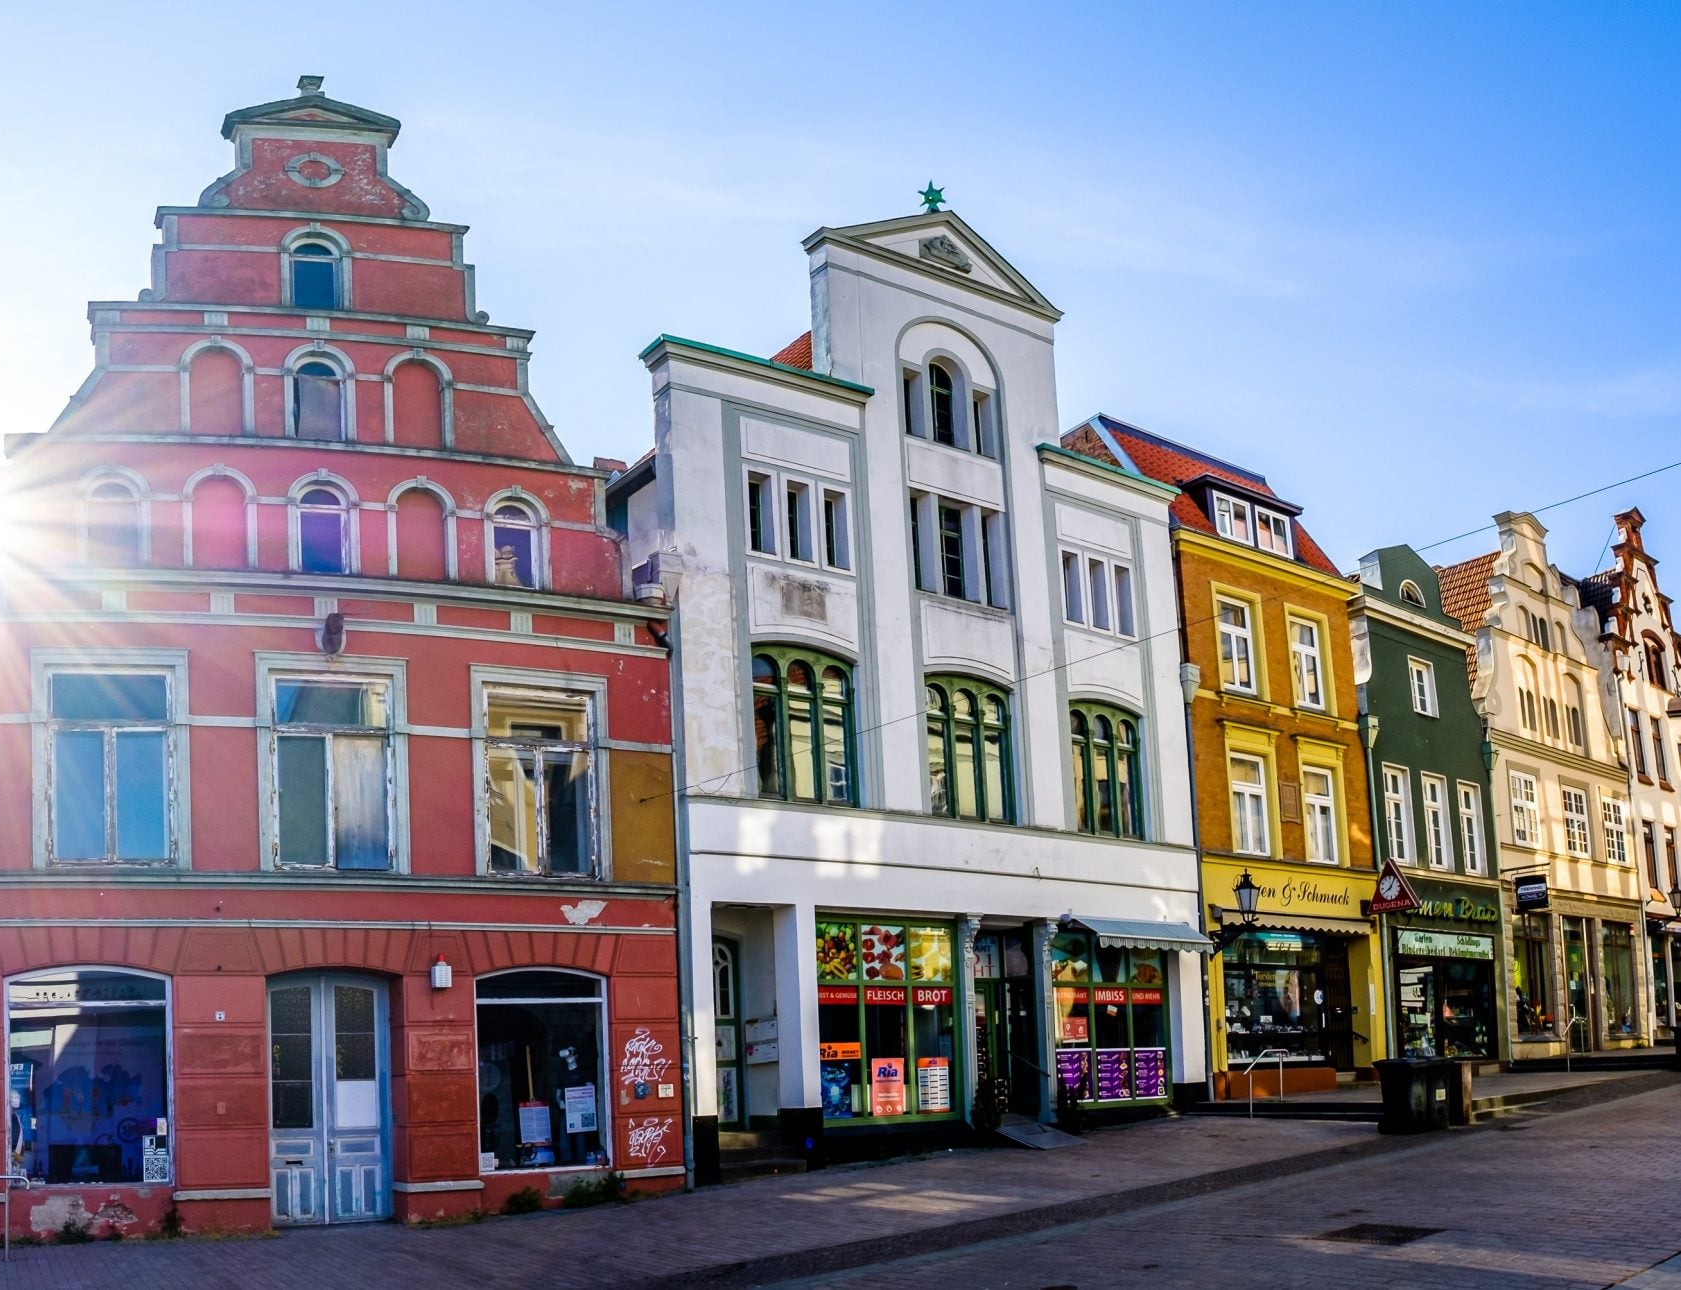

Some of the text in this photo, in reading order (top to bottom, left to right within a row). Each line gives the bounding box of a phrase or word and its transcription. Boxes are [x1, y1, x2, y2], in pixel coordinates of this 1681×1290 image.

[1297, 880, 1350, 906] Schmuck
[1372, 899, 1412, 911] DUGENA
[866, 990, 905, 1001] FLEISCH
[917, 990, 948, 1002] BROT
[1095, 990, 1125, 1001] IMBISS
[1132, 992, 1161, 1000] UND MEHR
[877, 1062, 898, 1078] Ria
